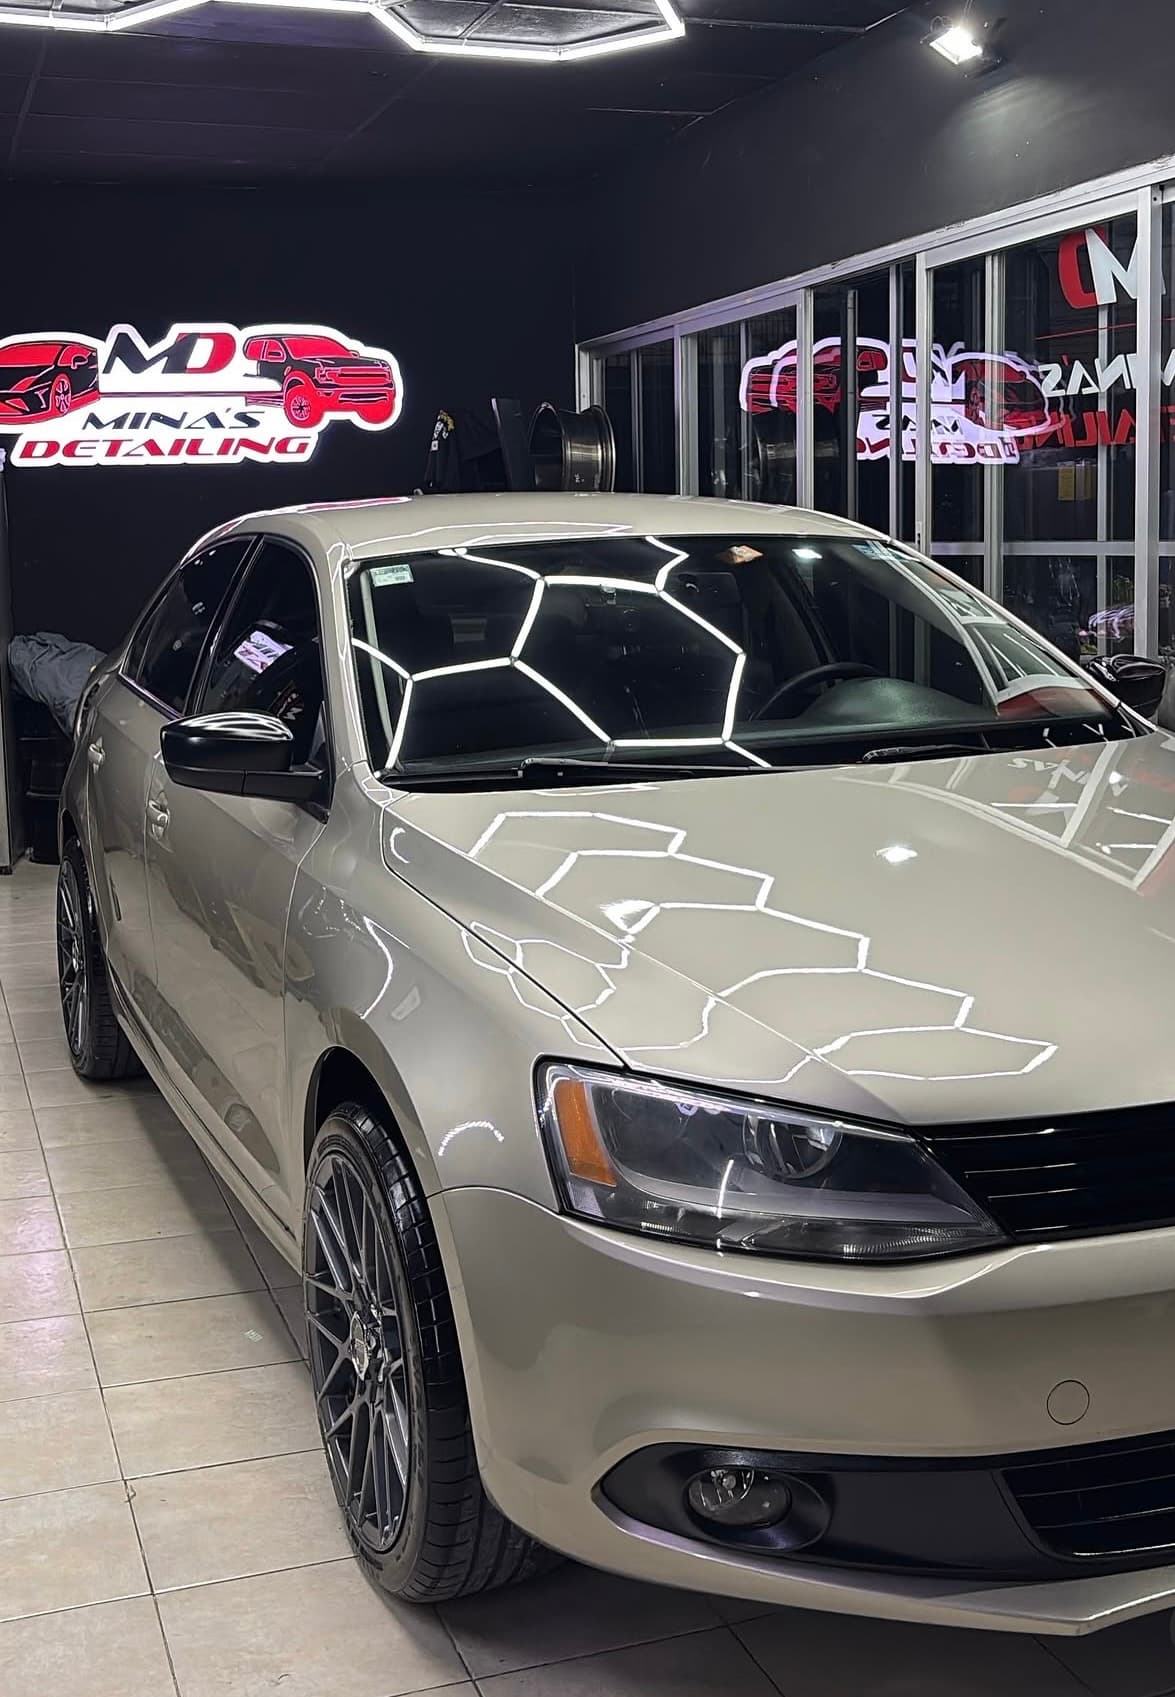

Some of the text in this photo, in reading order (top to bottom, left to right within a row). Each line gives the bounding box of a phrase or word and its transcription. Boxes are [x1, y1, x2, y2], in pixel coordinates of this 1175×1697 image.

[102, 331, 237, 375] MD
[81, 407, 265, 430] MINA'S
[19, 435, 312, 460] DETAILING
